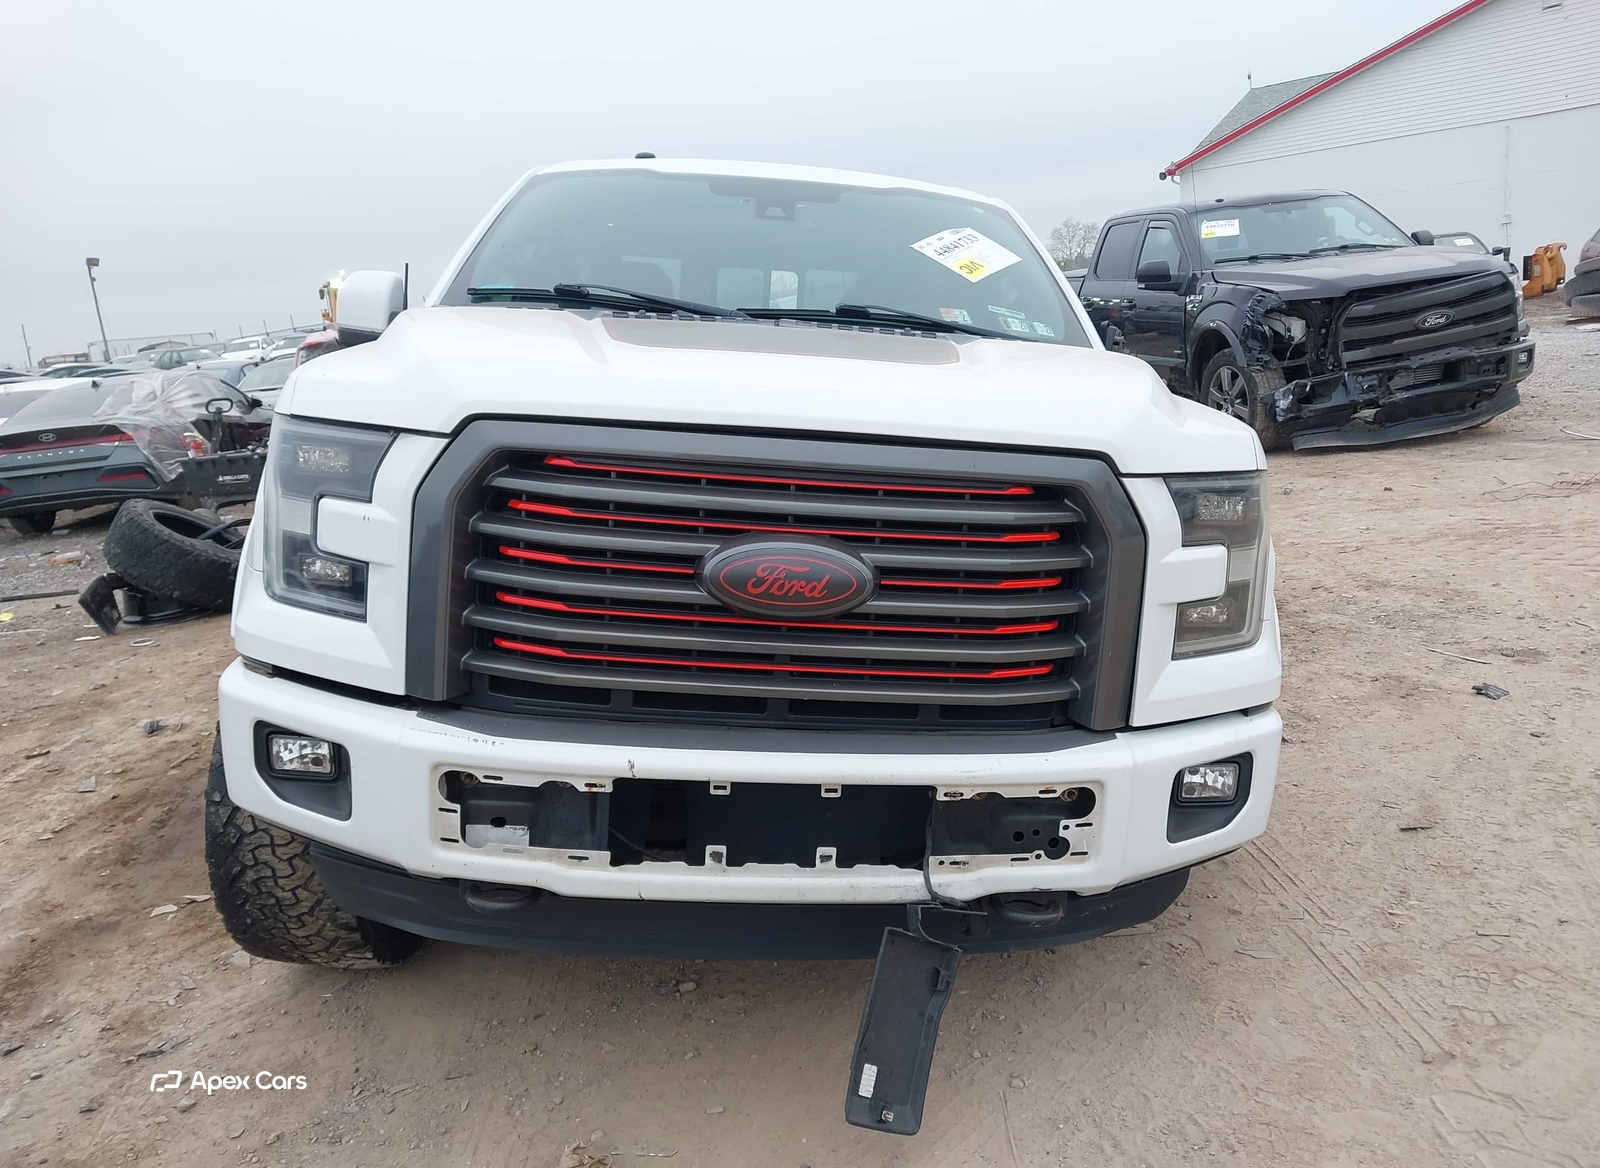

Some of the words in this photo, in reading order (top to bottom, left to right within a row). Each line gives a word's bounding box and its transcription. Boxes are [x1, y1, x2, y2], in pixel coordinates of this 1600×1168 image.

[933, 233, 980, 257] 44841733
[1425, 314, 1447, 326] Ford
[17, 448, 85, 460] ELANTRA
[746, 562, 831, 598] Ford
